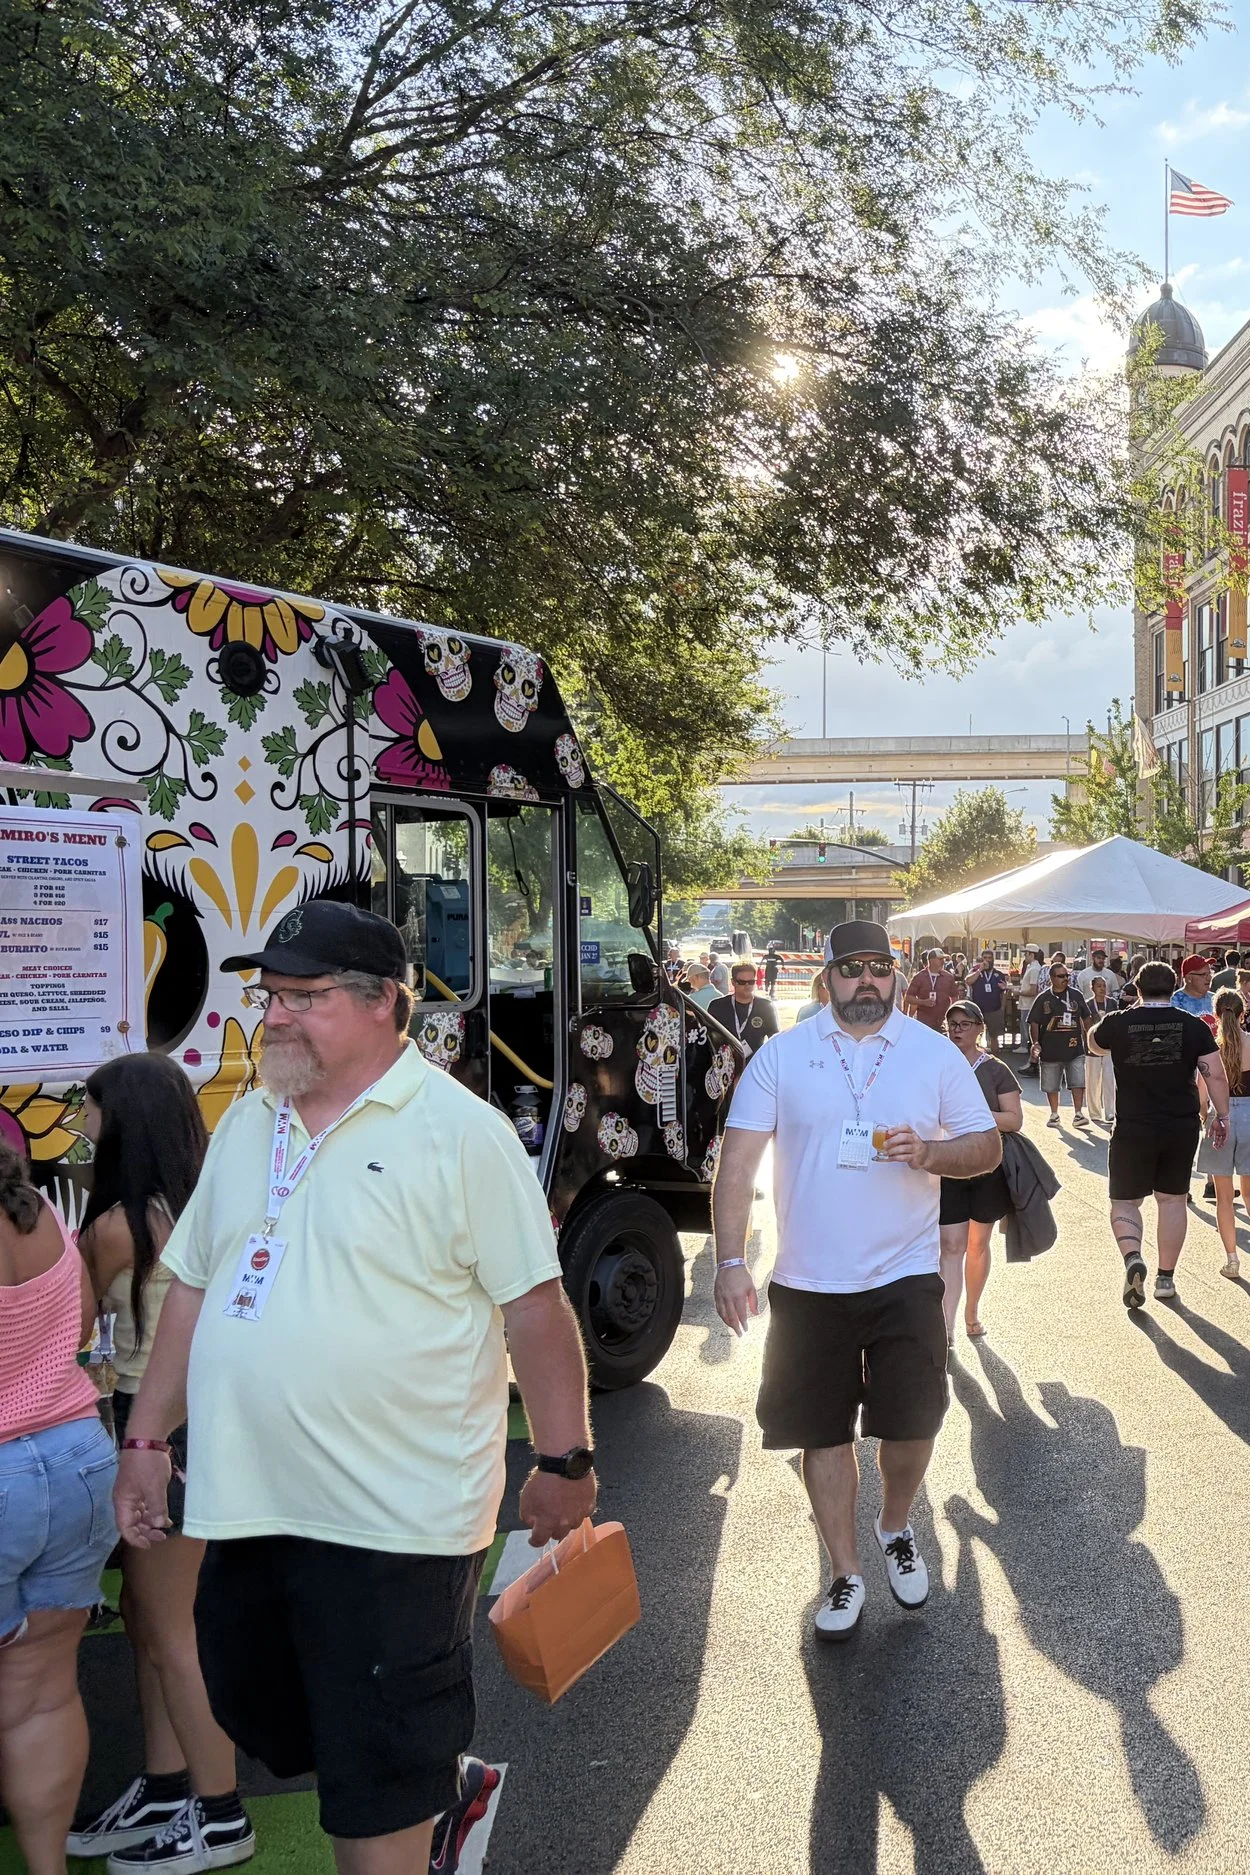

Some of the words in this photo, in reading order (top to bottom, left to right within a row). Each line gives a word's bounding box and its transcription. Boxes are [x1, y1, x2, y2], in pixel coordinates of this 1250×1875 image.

[0, 829, 60, 843] MIRO'S
[63, 833, 107, 846] MENU
[7, 855, 51, 865] STREET
[53, 857, 89, 867] TACOS
[17, 867, 48, 875] CHICKEN
[20, 917, 63, 926] NACHOS
[94, 918, 109, 926] $17
[93, 931, 109, 939] $15
[1, 945, 48, 953] BURRITO
[93, 943, 109, 951] $15
[581, 952, 591, 960] JAN
[22, 1028, 43, 1036] DIP
[46, 1027, 54, 1035] &
[56, 1026, 85, 1035] CHIPS
[687, 1025, 708, 1046] #3
[0, 1046, 18, 1055] DA
[20, 1045, 29, 1053] &
[31, 1043, 69, 1052] WATER
